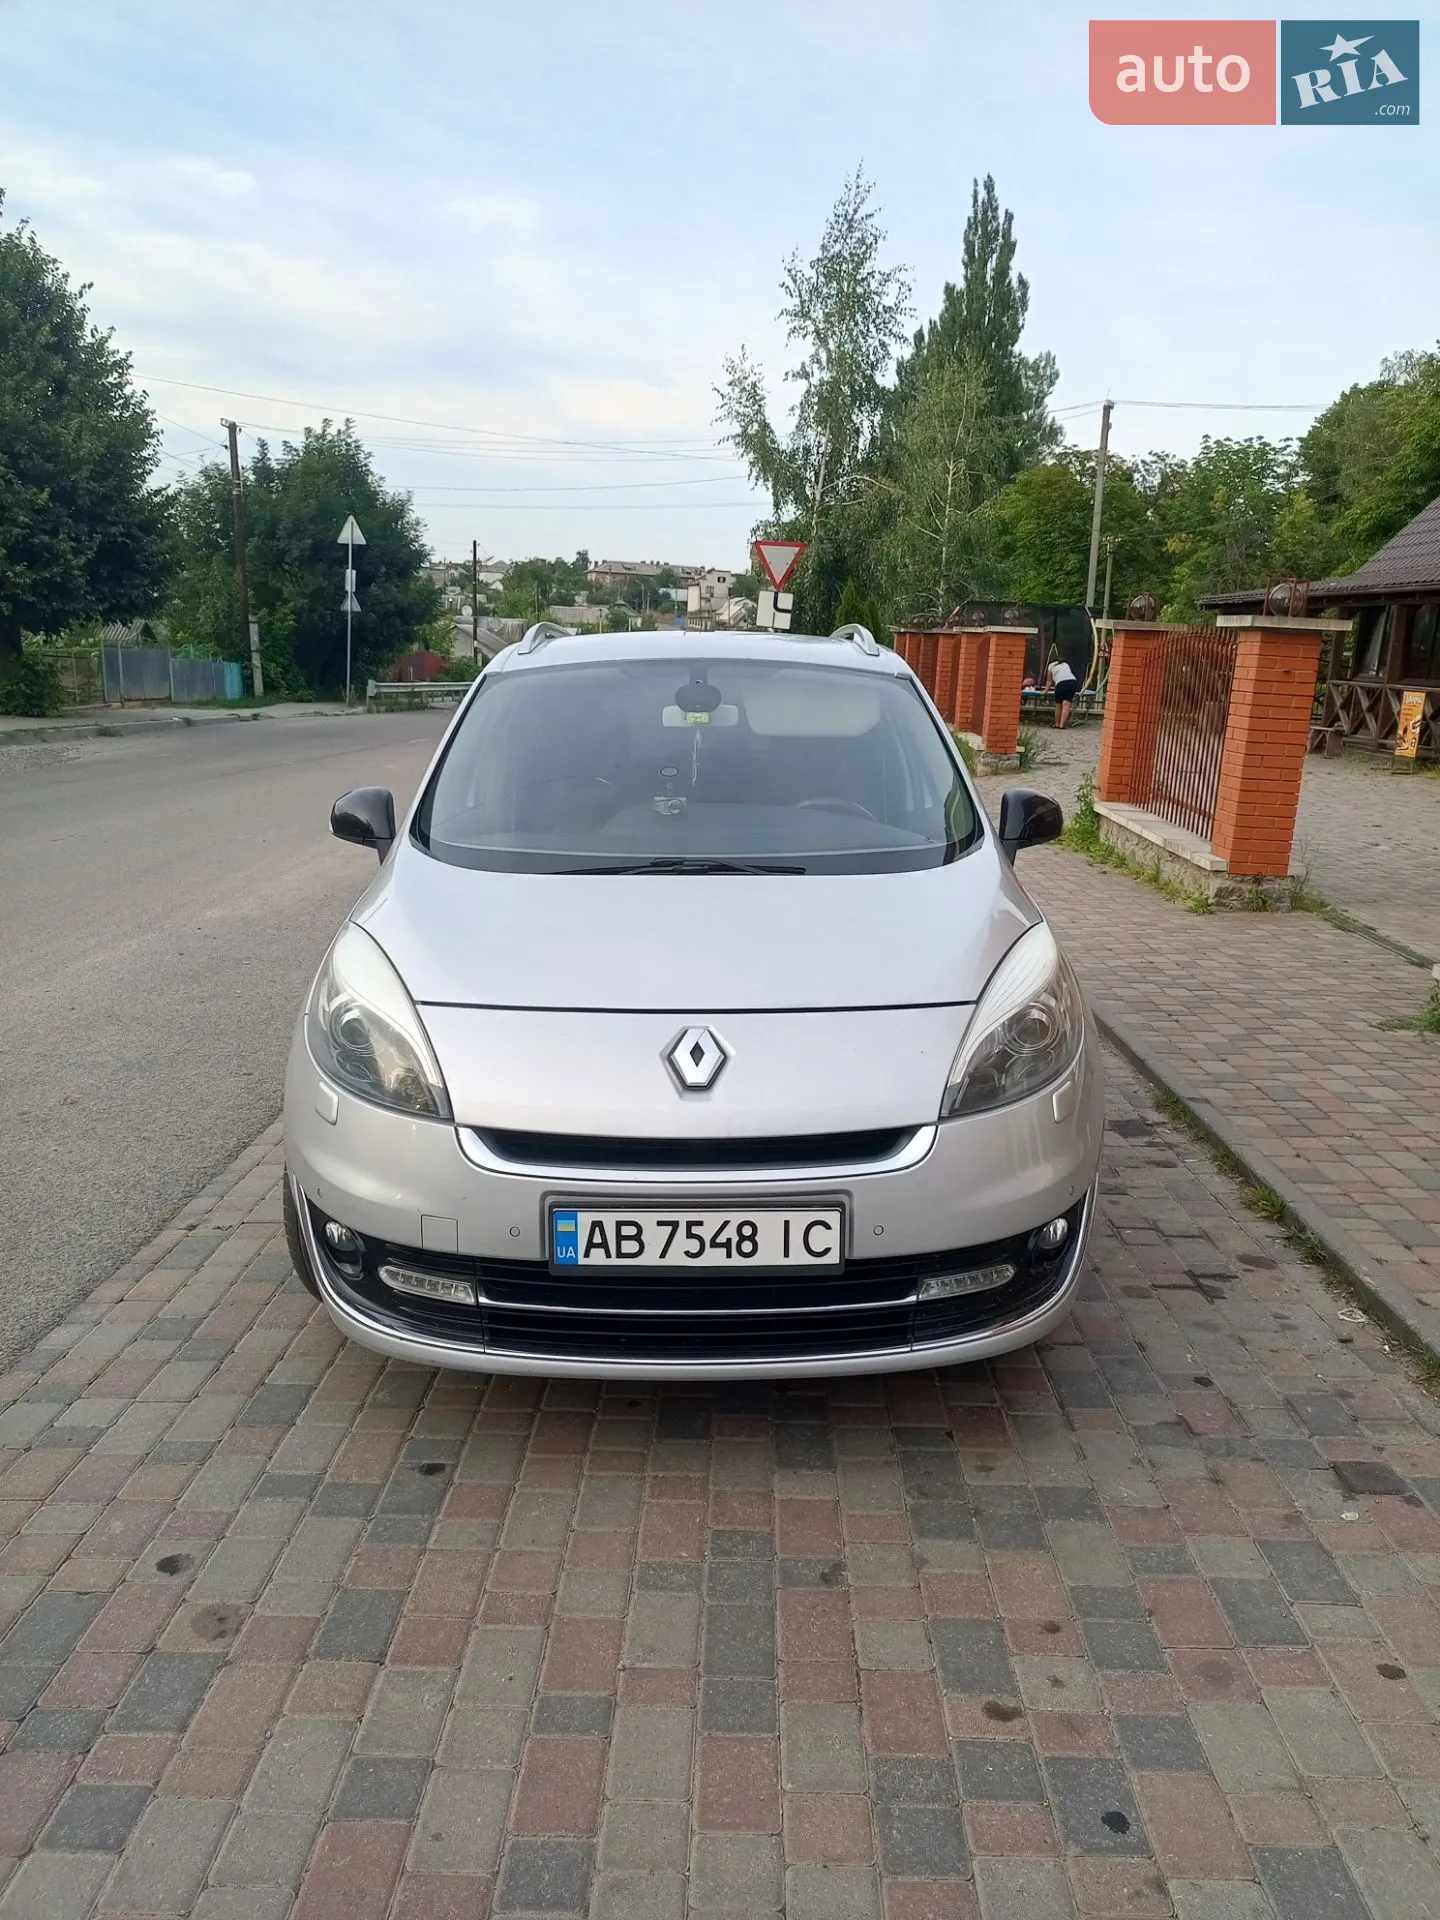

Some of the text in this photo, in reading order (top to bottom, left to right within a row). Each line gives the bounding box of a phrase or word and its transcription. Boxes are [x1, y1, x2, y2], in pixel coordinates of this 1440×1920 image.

[557, 1246, 576, 1259] UA
[583, 1219, 833, 1260] AB 7548 IC
